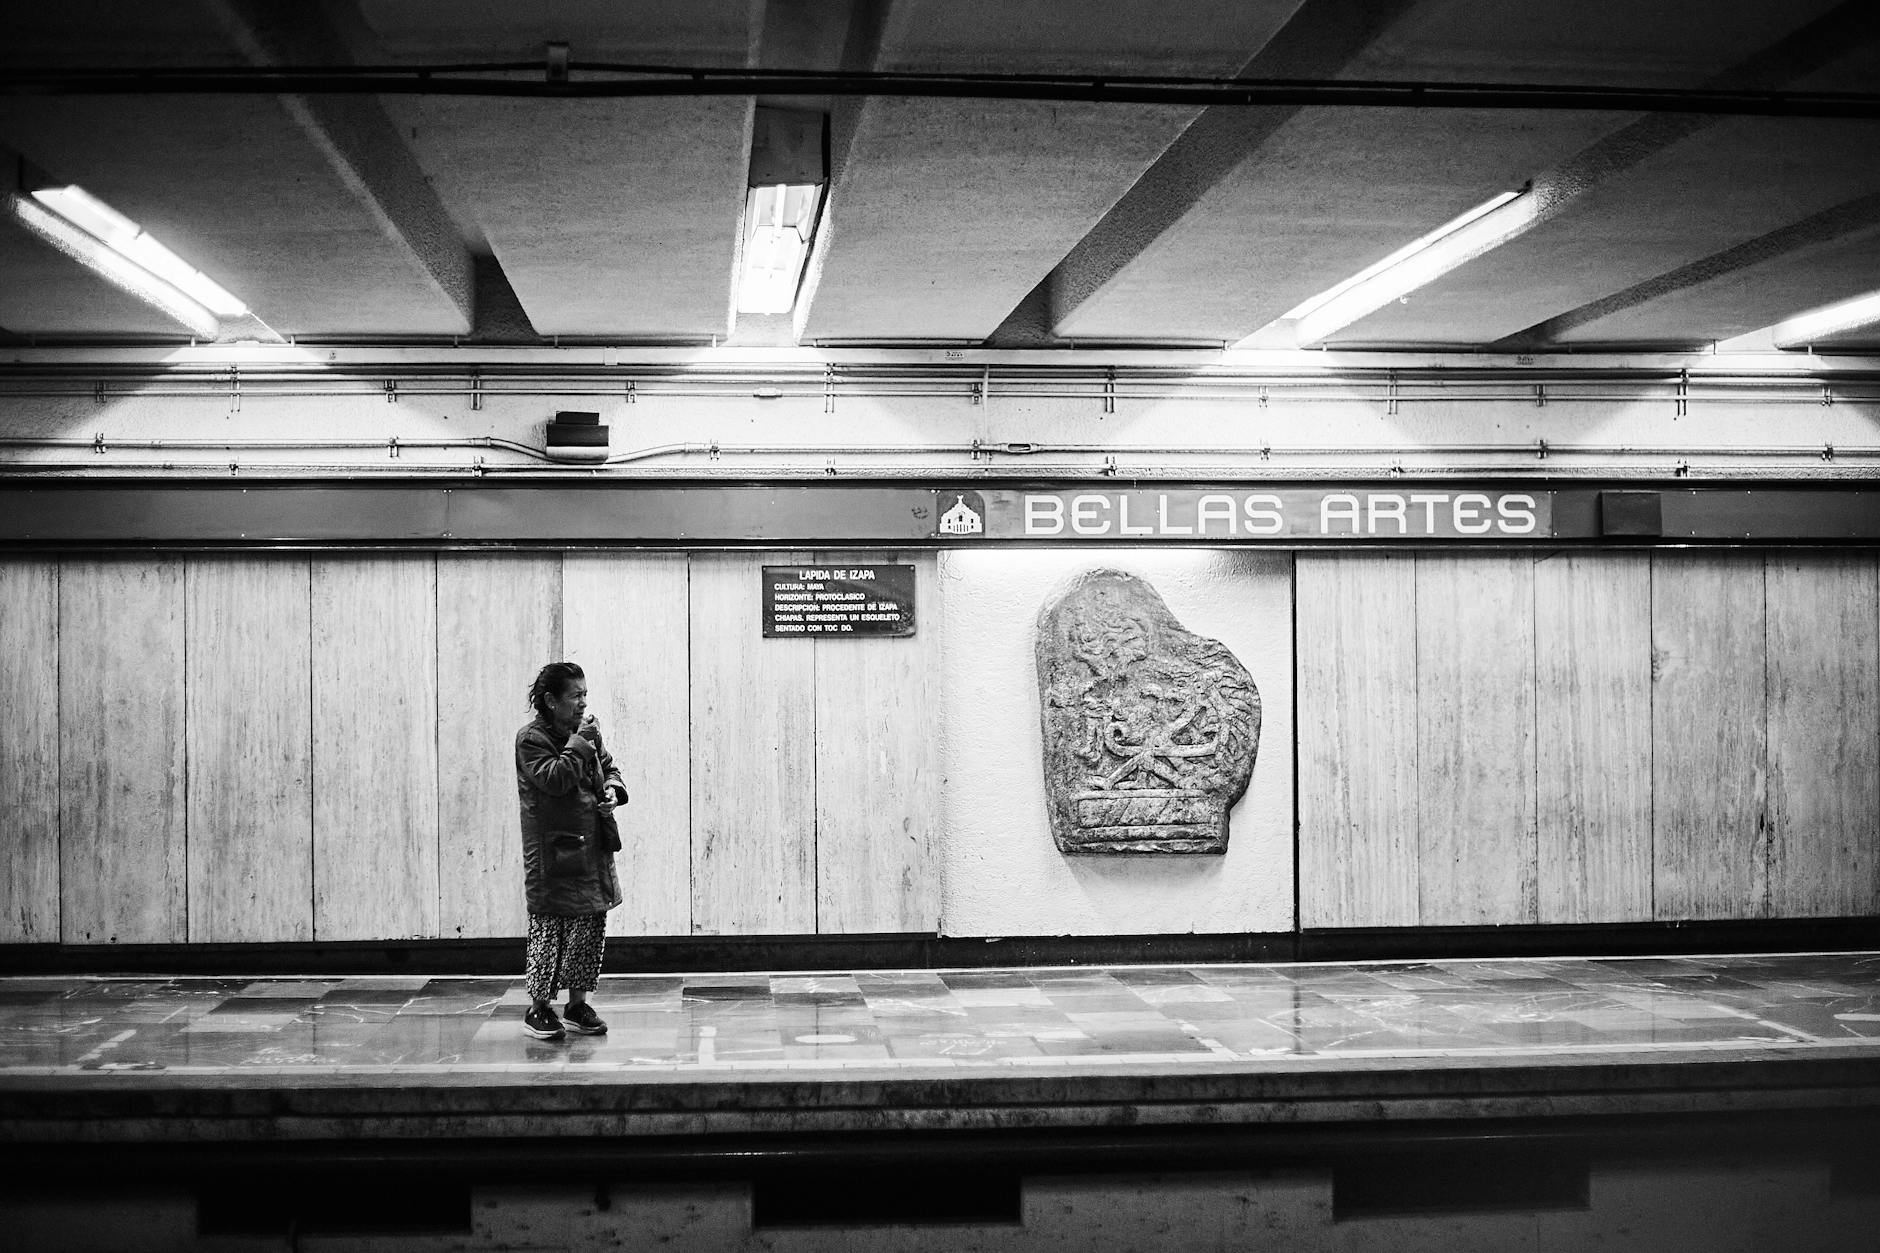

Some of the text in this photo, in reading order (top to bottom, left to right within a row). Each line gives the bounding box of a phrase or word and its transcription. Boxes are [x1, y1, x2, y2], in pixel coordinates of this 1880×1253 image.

[1024, 493, 1536, 536] BELLAS ARTES
[799, 570, 875, 580] LAPIDA DE IZAPA
